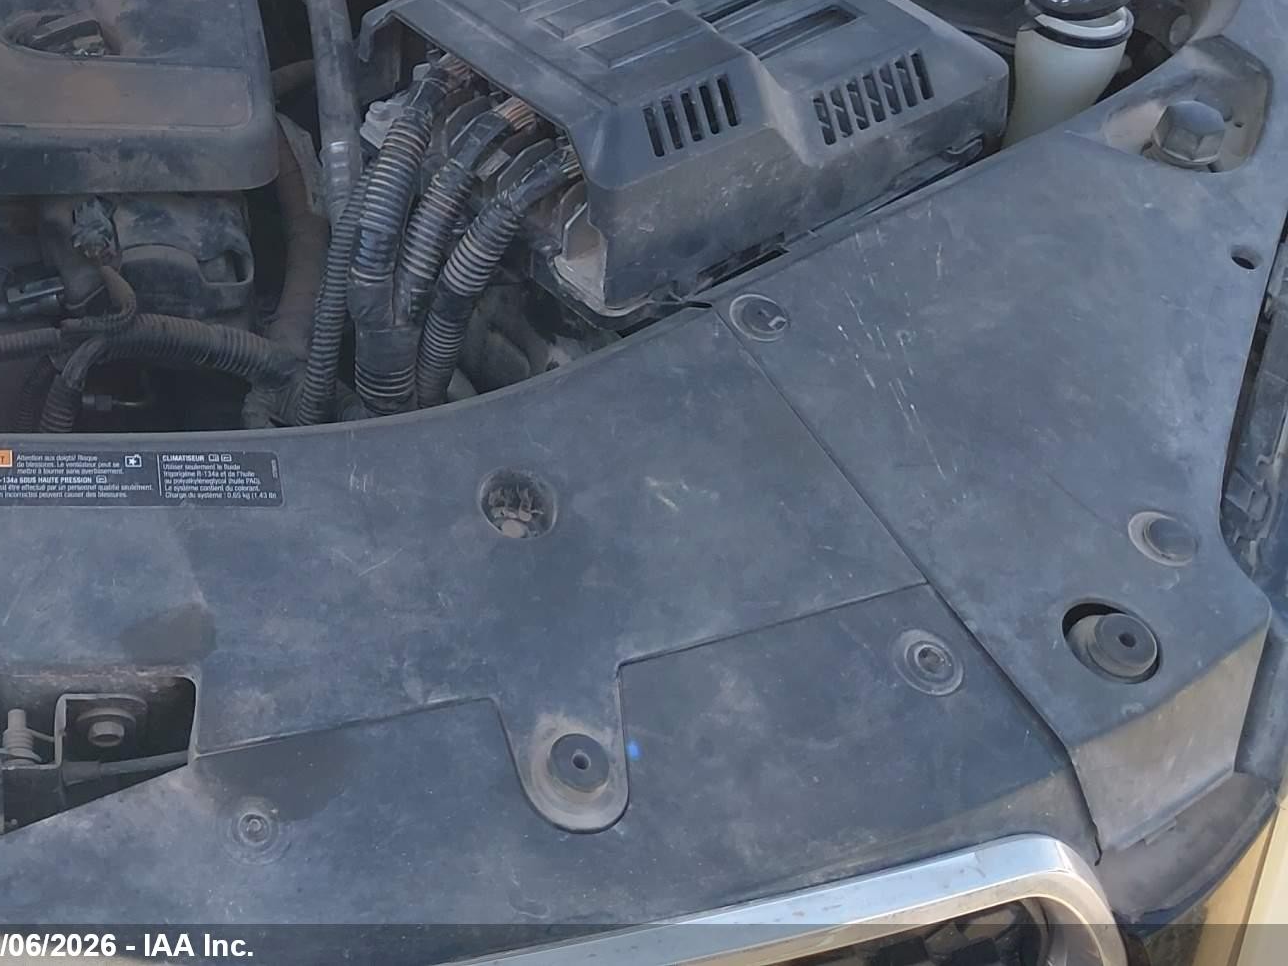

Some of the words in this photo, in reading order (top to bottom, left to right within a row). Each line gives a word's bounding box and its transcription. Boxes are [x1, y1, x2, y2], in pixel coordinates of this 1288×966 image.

[19, 475, 36, 483] SOUS
[38, 475, 59, 483] HAUTE
[60, 475, 92, 483] PRESSION
